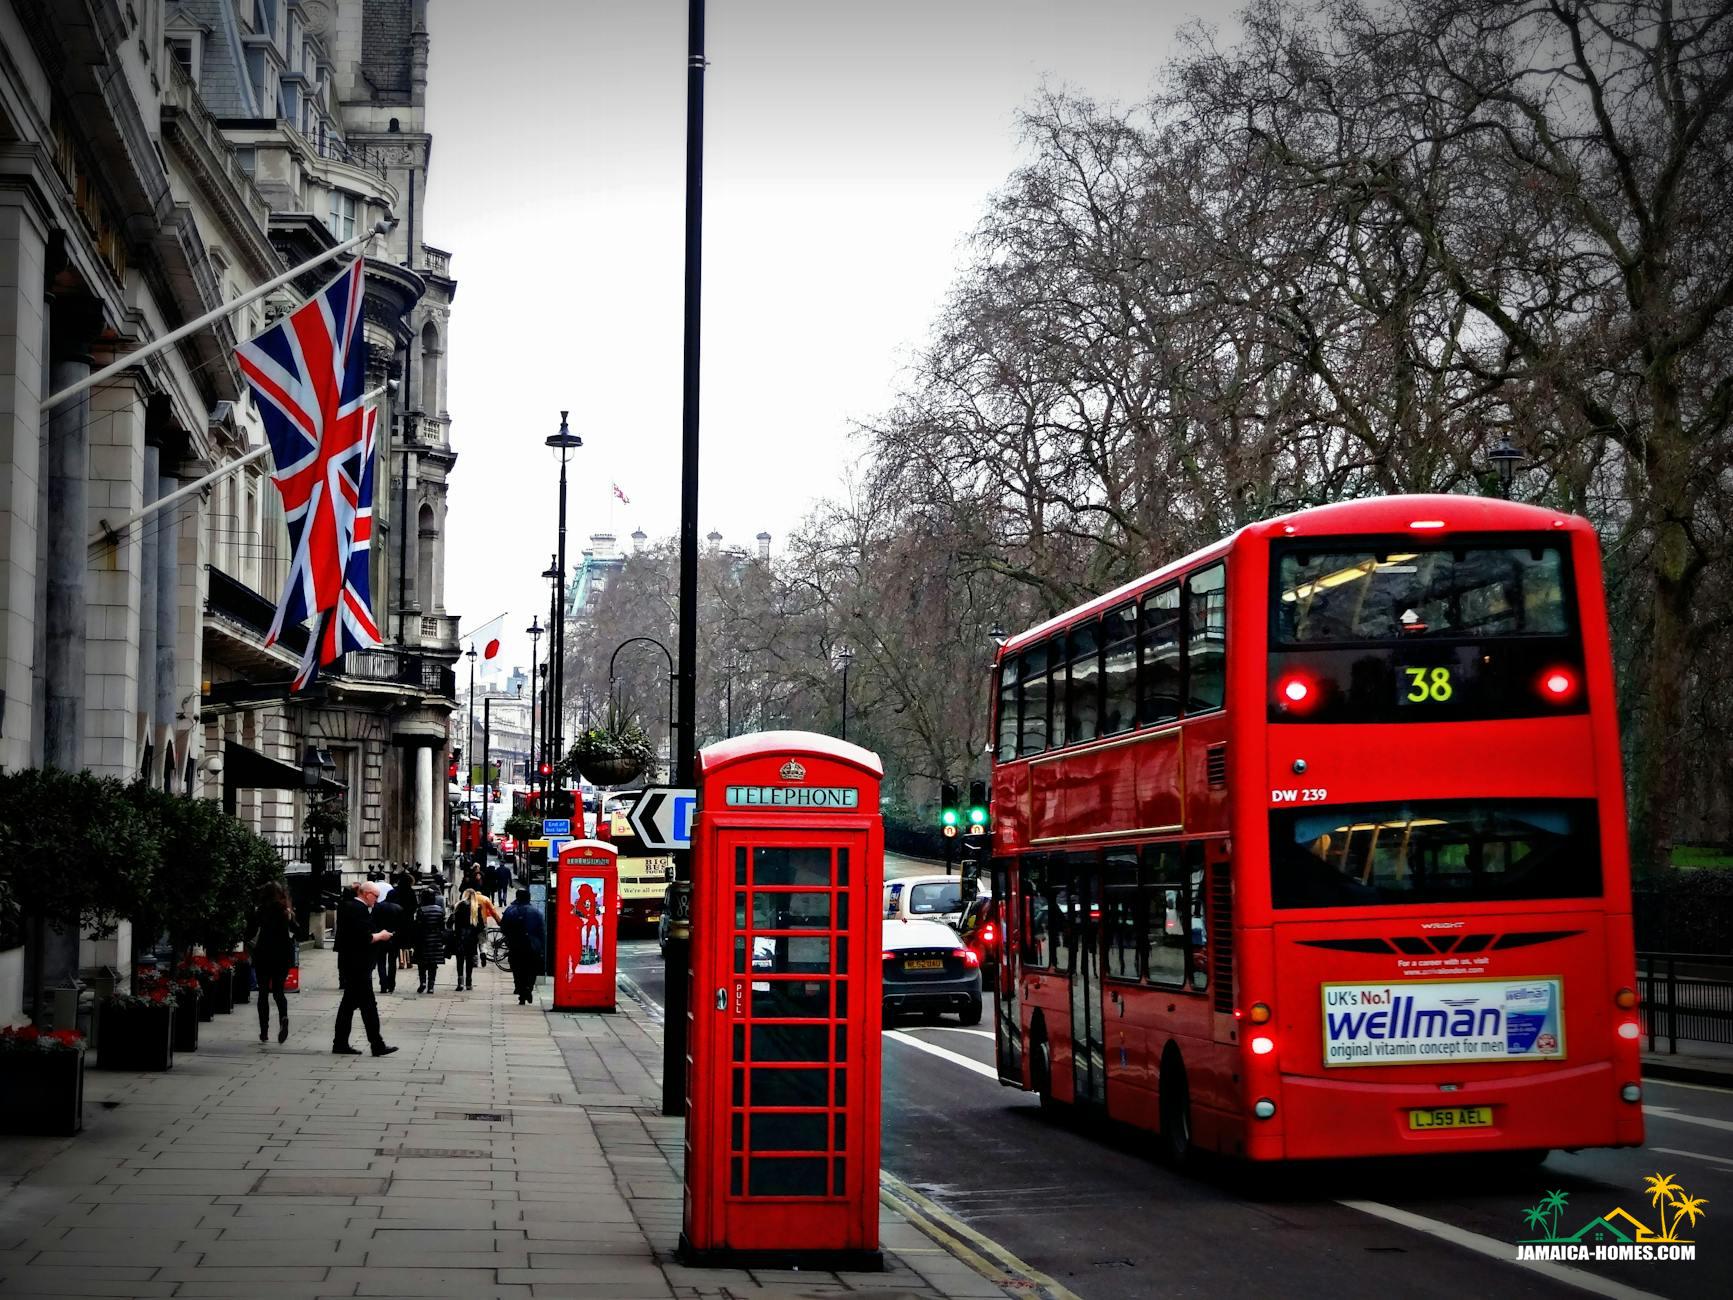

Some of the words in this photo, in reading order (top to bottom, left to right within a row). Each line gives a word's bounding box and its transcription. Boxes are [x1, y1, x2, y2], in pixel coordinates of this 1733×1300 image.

[1405, 667, 1453, 702] 38
[729, 787, 853, 806] TELEPHONE
[1271, 790, 1298, 802] DW
[1302, 789, 1328, 801] 239
[735, 983, 743, 1014] PULL
[1327, 991, 1358, 1006] UK's
[1361, 989, 1391, 1005] No.1
[1327, 996, 1502, 1041] wellman
[1330, 1041, 1372, 1060] original
[1375, 1040, 1417, 1056] vitamin
[1419, 1039, 1460, 1057] concept
[1462, 1038, 1481, 1053] for
[1483, 1041, 1504, 1053] men
[1415, 1112, 1454, 1127] LJ59
[1459, 1110, 1487, 1125] AEL
